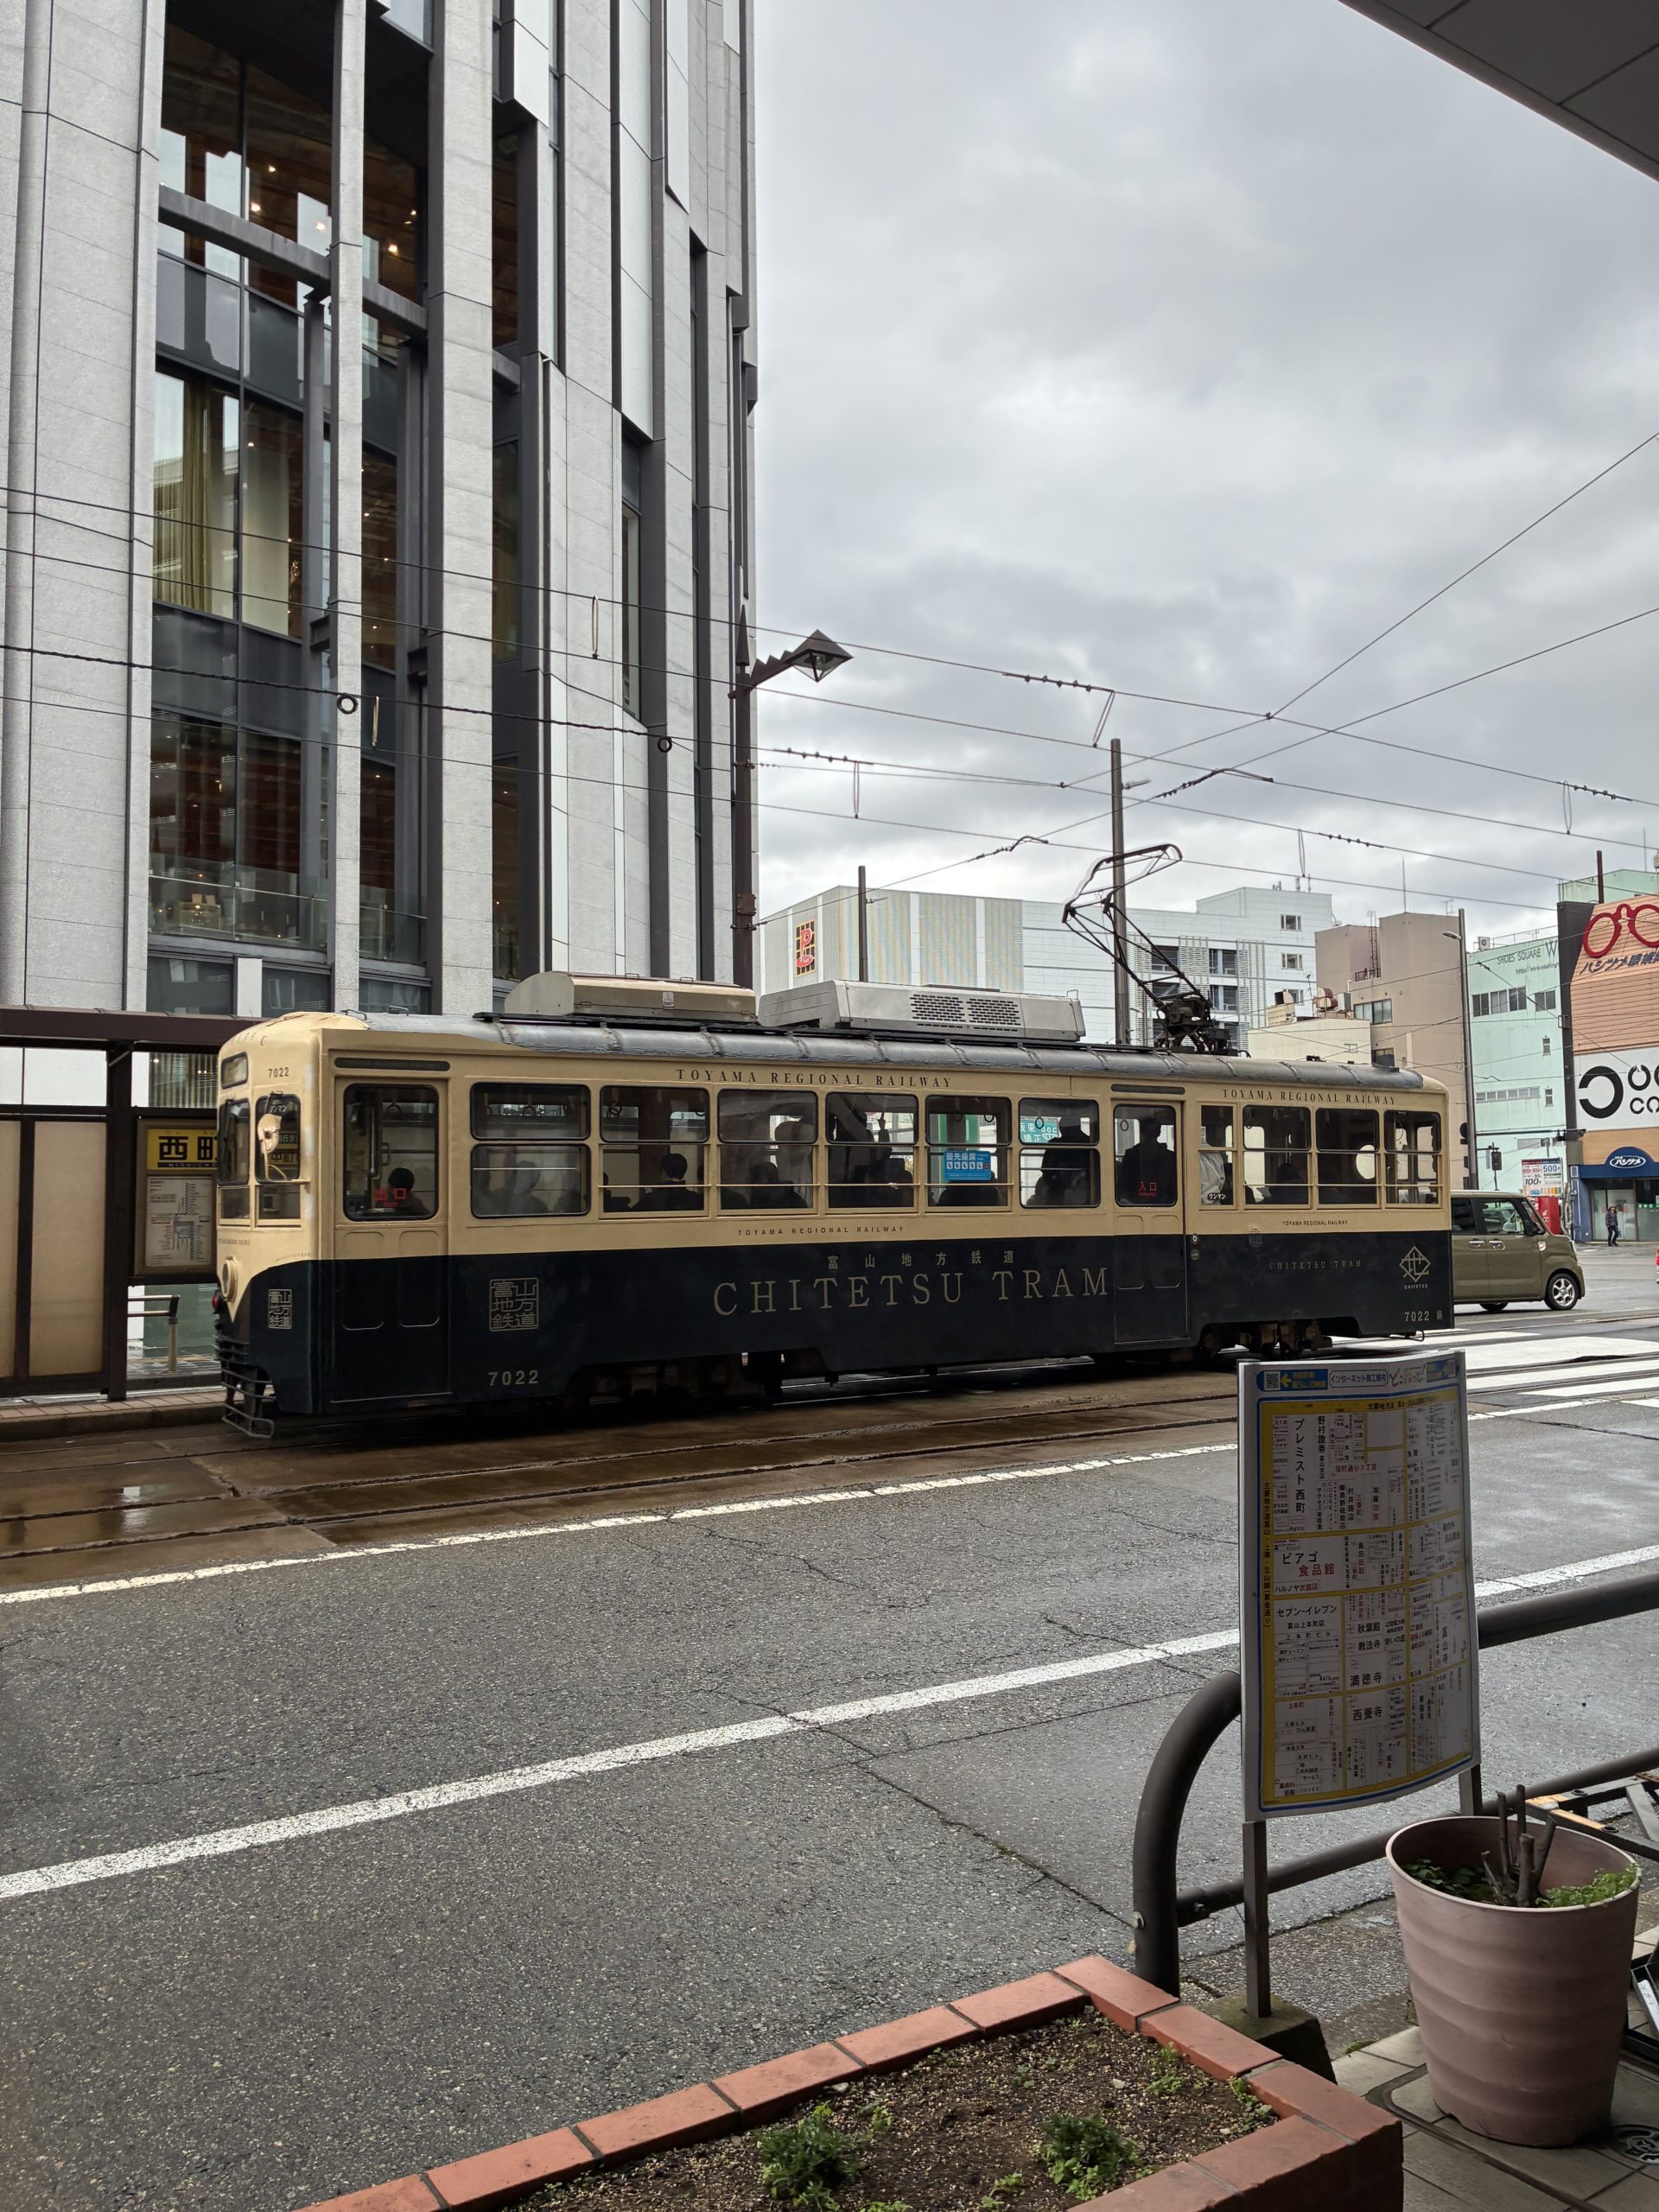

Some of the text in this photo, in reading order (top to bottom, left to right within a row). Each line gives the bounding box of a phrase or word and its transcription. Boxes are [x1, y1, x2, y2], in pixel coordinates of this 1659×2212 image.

[1497, 955, 1515, 964] SHOES
[1518, 949, 1541, 961] SQUARE
[268, 1067, 289, 1079] 7022
[676, 1069, 951, 1088] TOYAMA REGIONAL RAILWAY
[1222, 1089, 1395, 1105] TOYAMA REGIONAL RAILWAY
[1139, 1181, 1157, 1192] 入口
[373, 1188, 406, 1202] 出口
[827, 1250, 1014, 1270] 富山地方鉄道
[1269, 1259, 1362, 1270] CHITETSU TRAM
[713, 1268, 1109, 1316] CHITETSU TRAM
[1404, 1310, 1430, 1322] 7022
[488, 1370, 539, 1387] 7022
[1294, 1418, 1306, 1513] プレミスト西町
[1282, 1550, 1319, 1565] ピアゴ
[1299, 1562, 1335, 1578] 食品館
